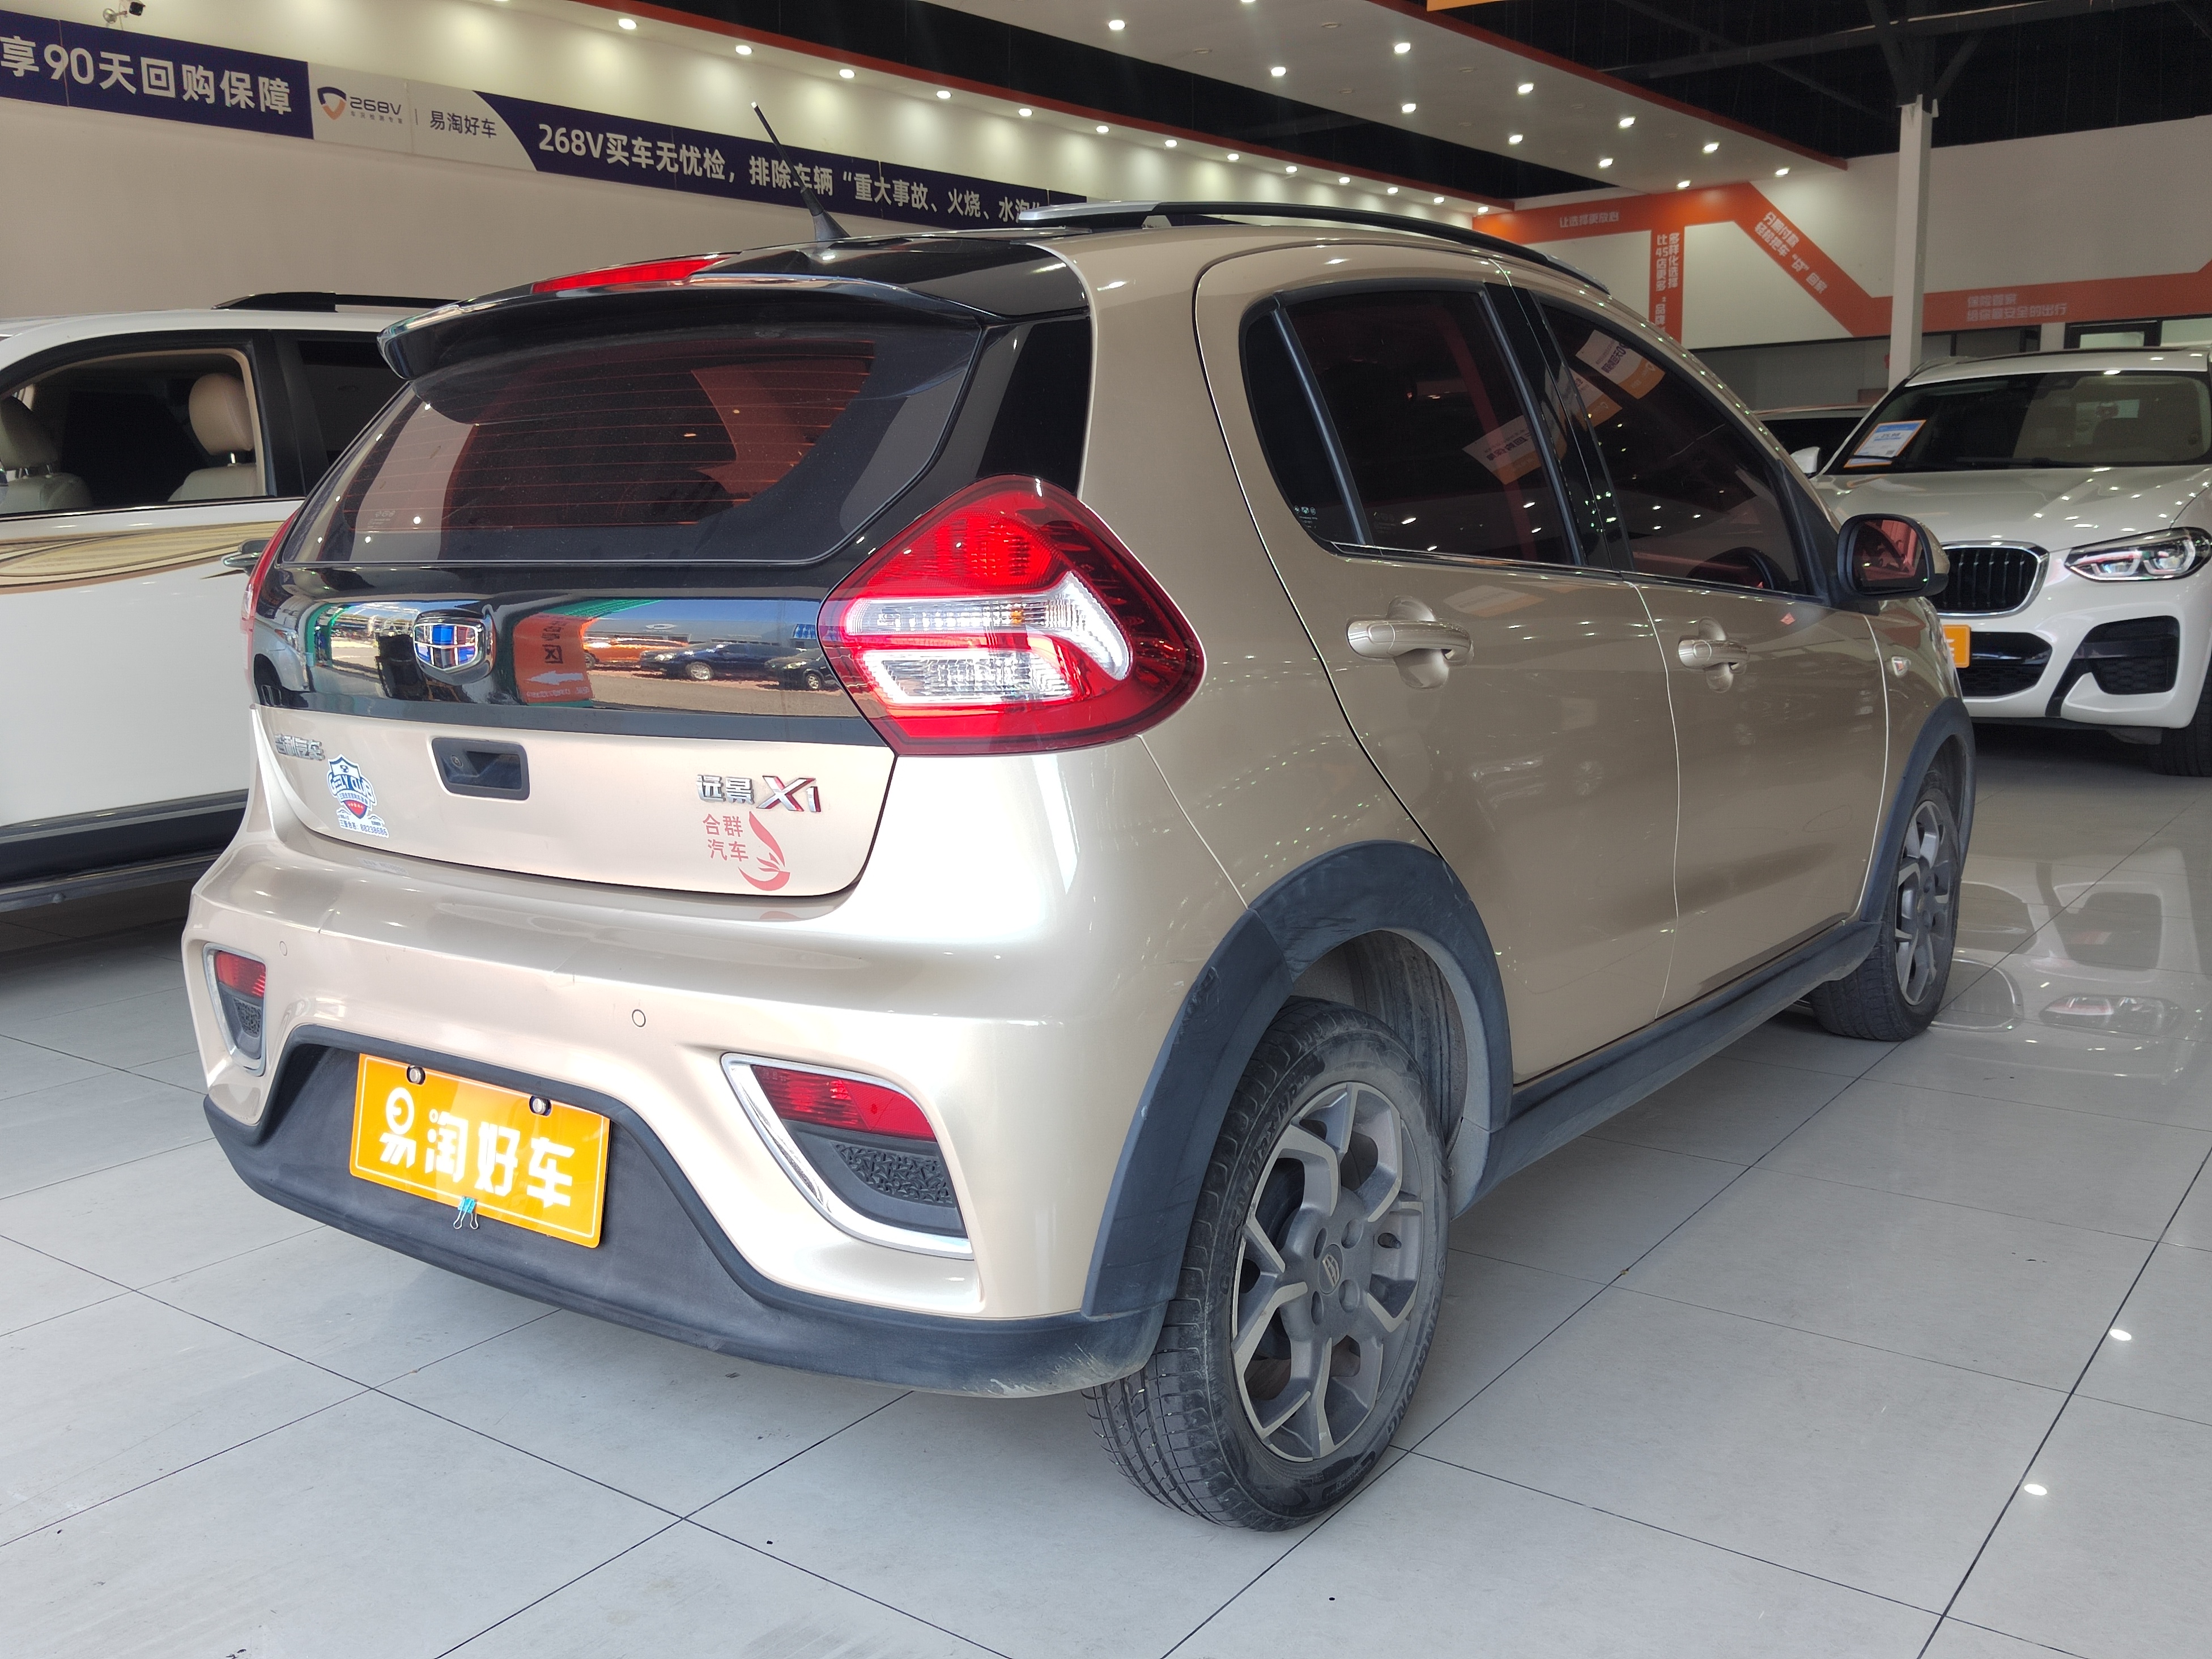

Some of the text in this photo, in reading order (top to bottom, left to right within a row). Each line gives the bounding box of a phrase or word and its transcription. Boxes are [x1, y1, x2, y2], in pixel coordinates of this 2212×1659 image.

[1, 35, 292, 115] 享90天回购保障
[350, 96, 402, 115] 268V
[430, 110, 497, 138] 易淘好车
[696, 774, 822, 813] 远景 X1
[703, 814, 743, 837] 合群
[707, 839, 749, 862] 汽车
[378, 1086, 575, 1209] 易淘好车
